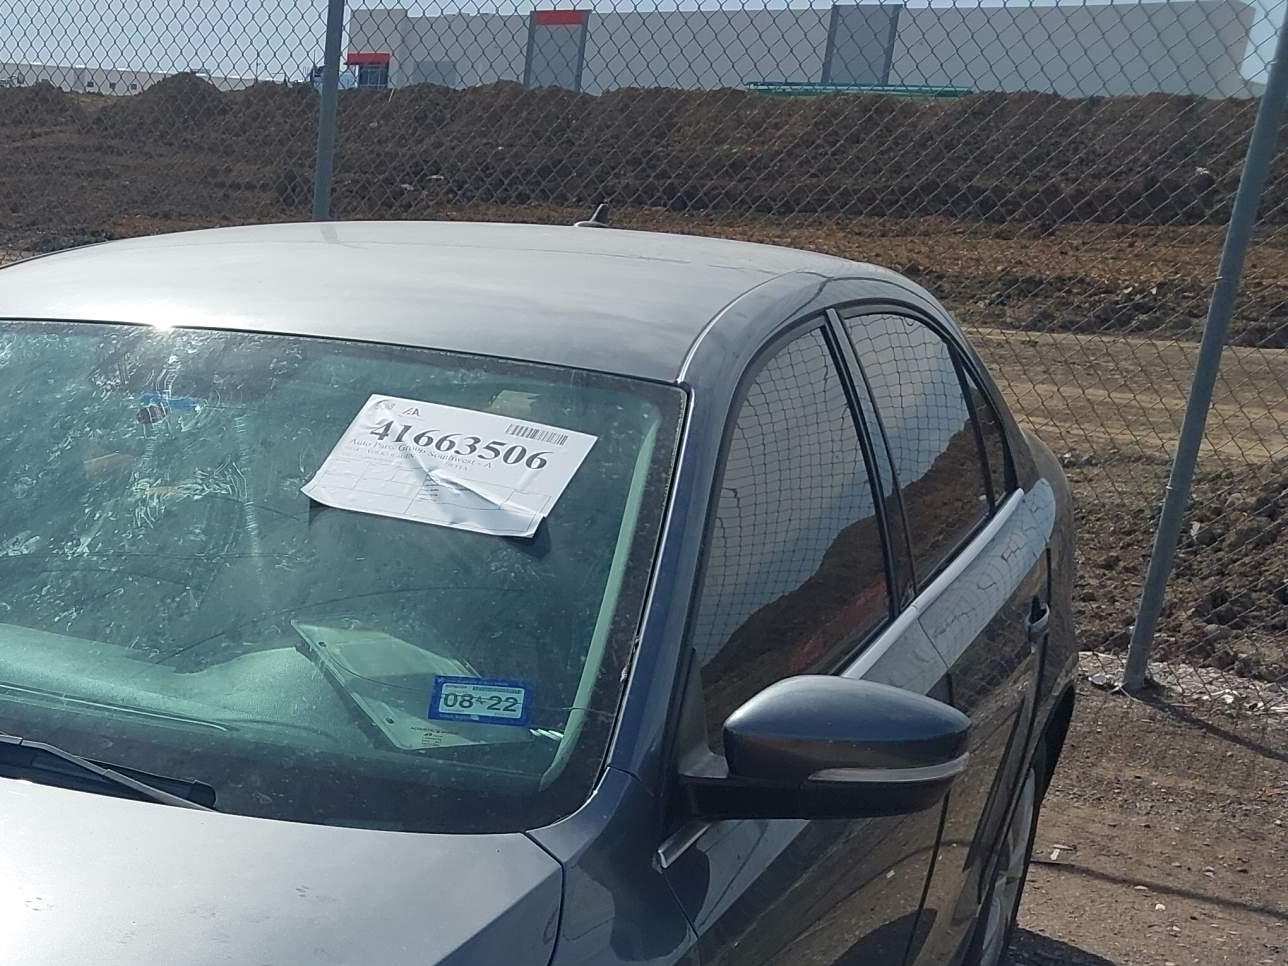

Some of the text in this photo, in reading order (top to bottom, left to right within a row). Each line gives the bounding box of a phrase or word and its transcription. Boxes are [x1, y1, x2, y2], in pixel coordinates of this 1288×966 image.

[369, 419, 553, 471] 41663506
[443, 692, 519, 713] 08 22
